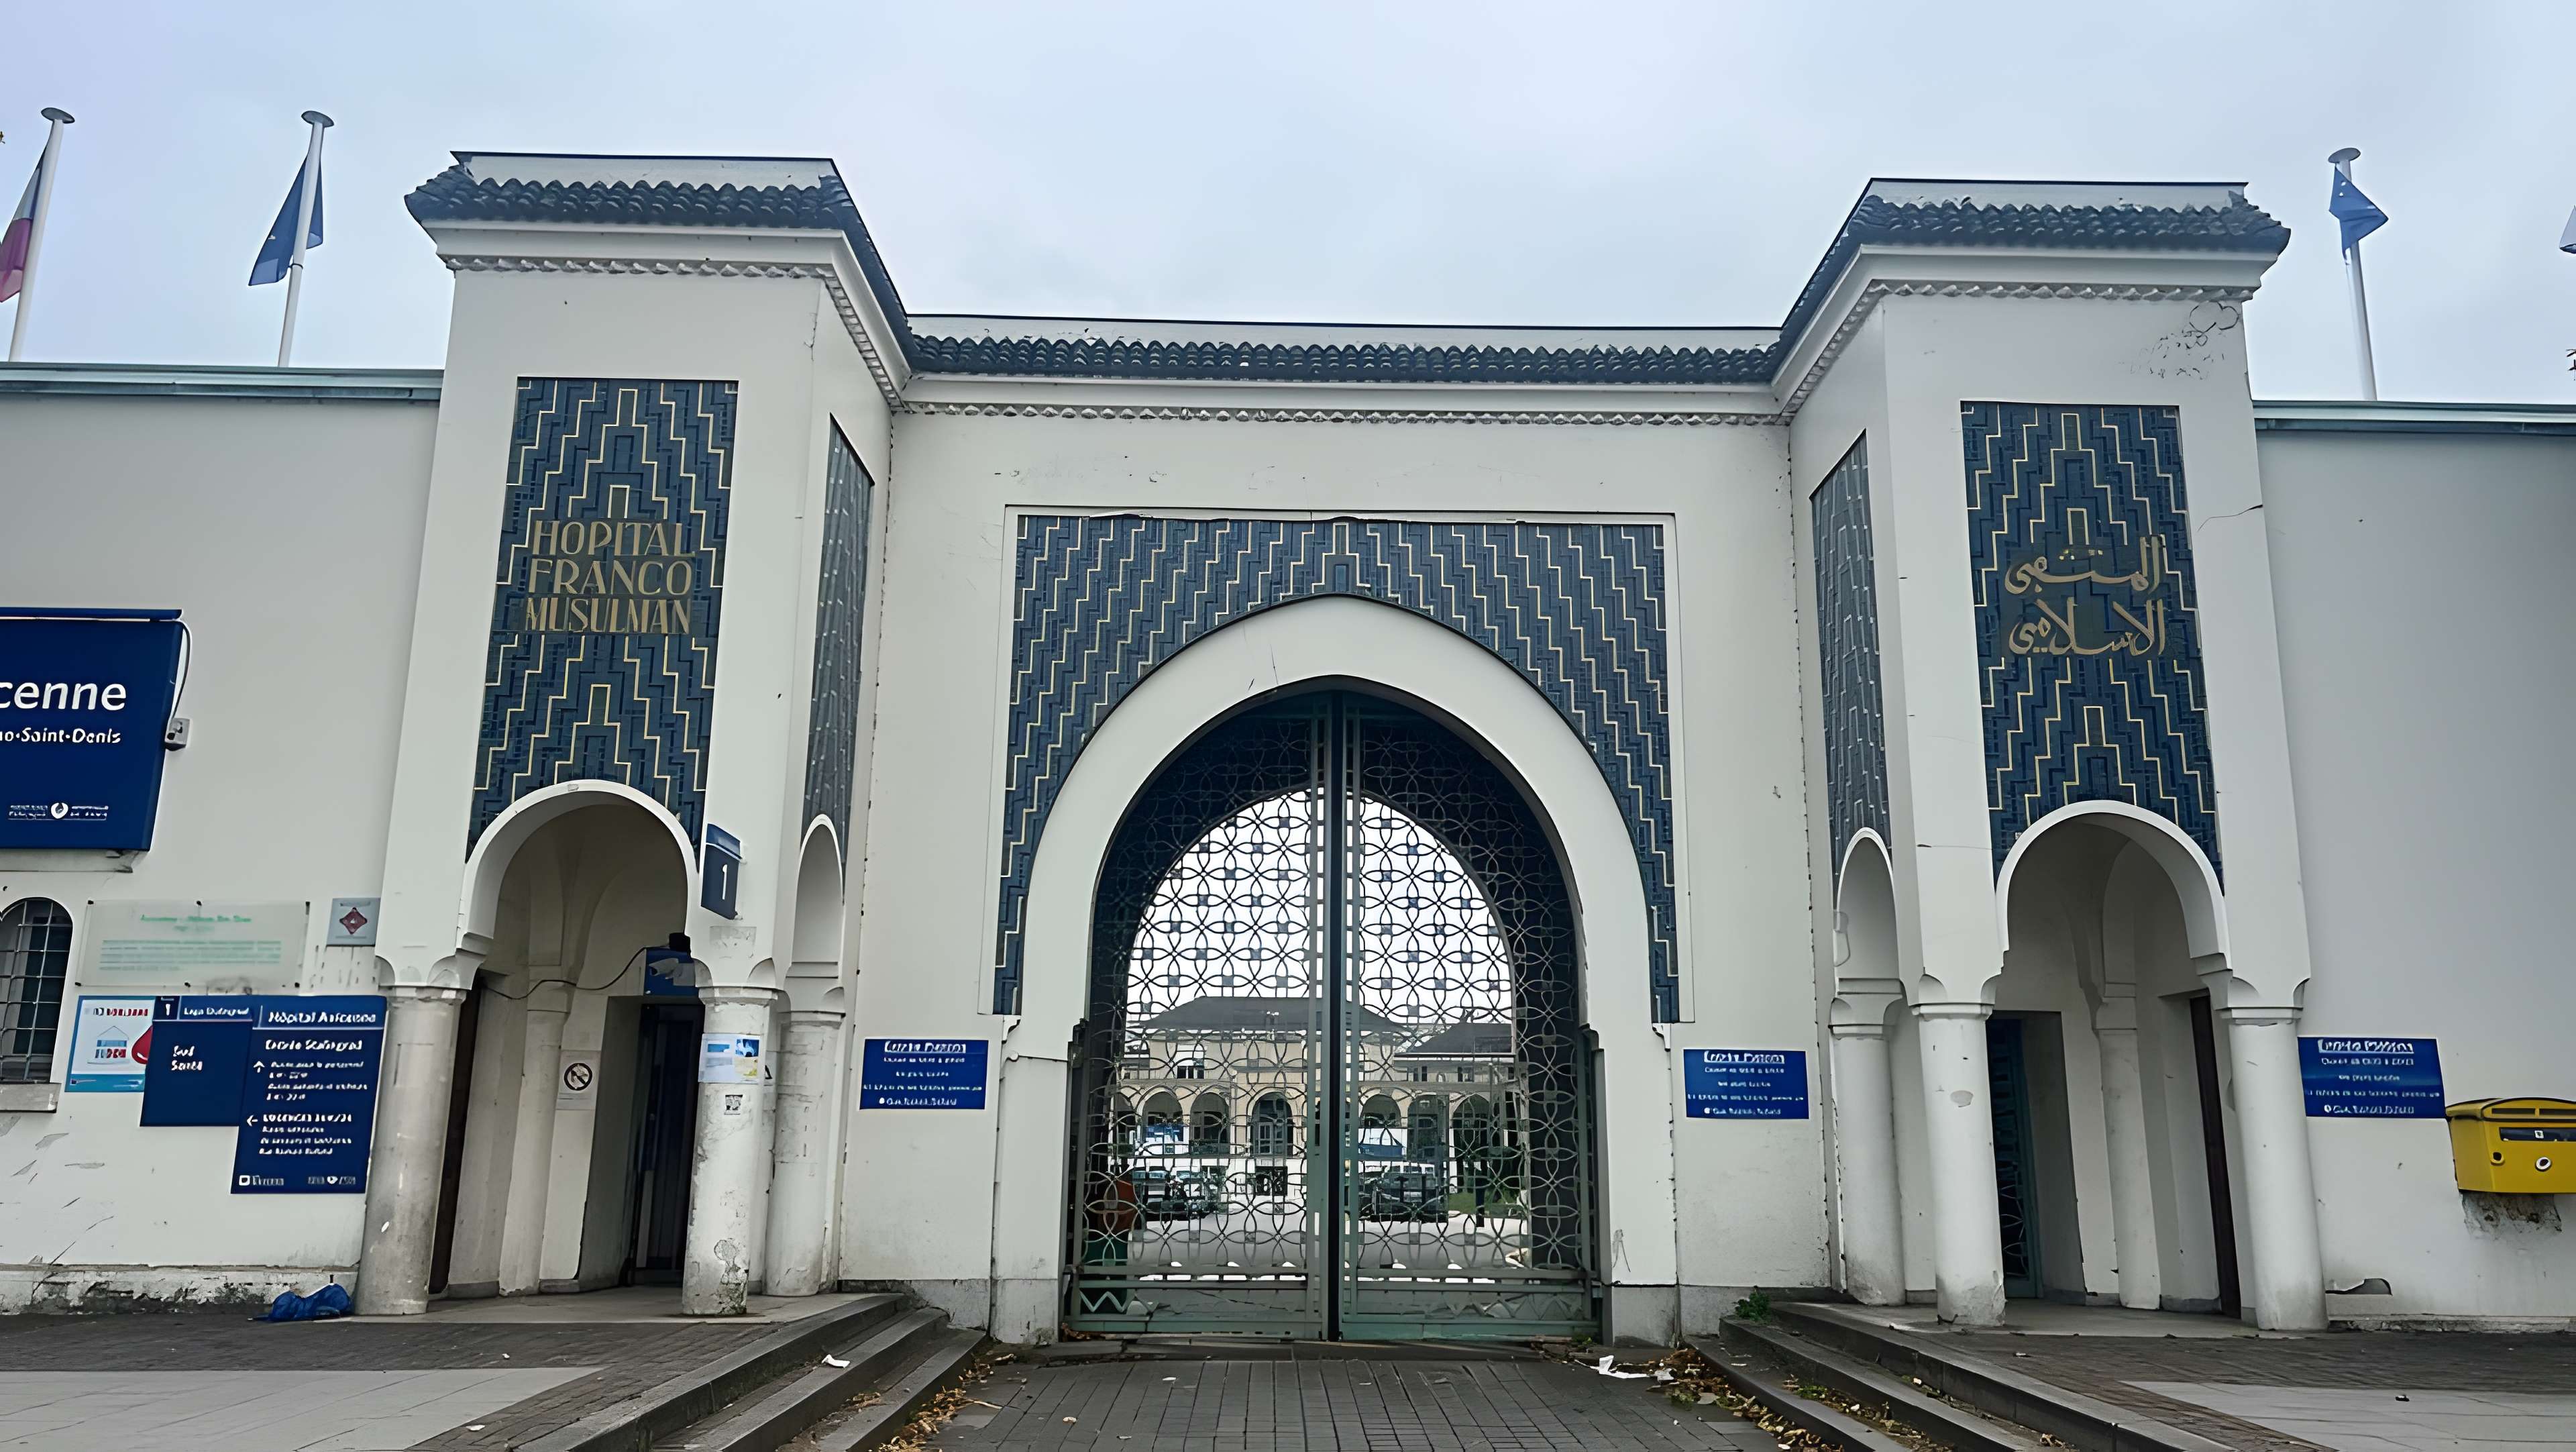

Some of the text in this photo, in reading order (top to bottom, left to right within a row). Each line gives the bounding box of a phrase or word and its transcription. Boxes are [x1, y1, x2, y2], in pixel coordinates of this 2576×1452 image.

[532, 521, 696, 556] HOPITAL
[528, 558, 692, 595] FRANCO
[525, 597, 692, 635] MUSULMAN
